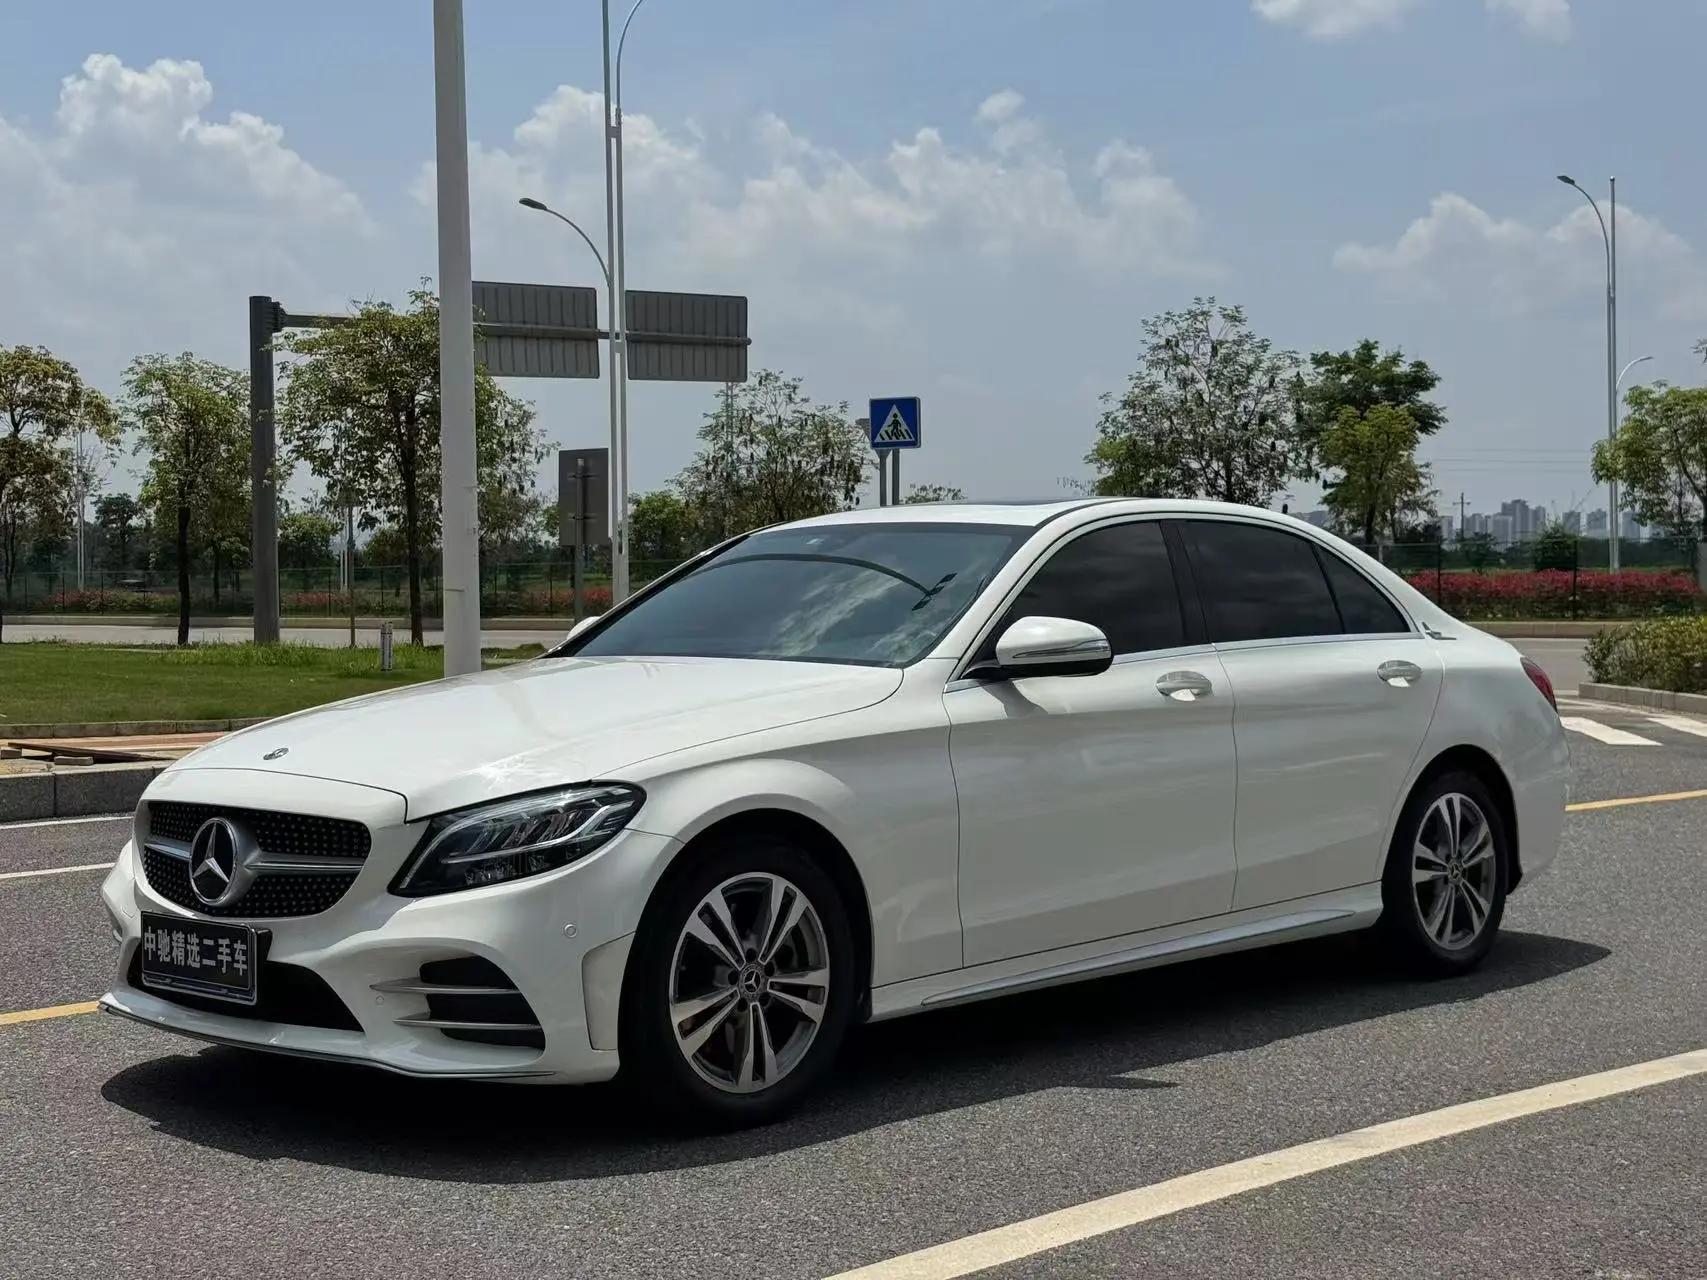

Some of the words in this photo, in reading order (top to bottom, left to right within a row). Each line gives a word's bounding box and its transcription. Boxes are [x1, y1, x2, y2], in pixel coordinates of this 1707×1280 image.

[144, 925, 248, 977] 中驰精选二手车
